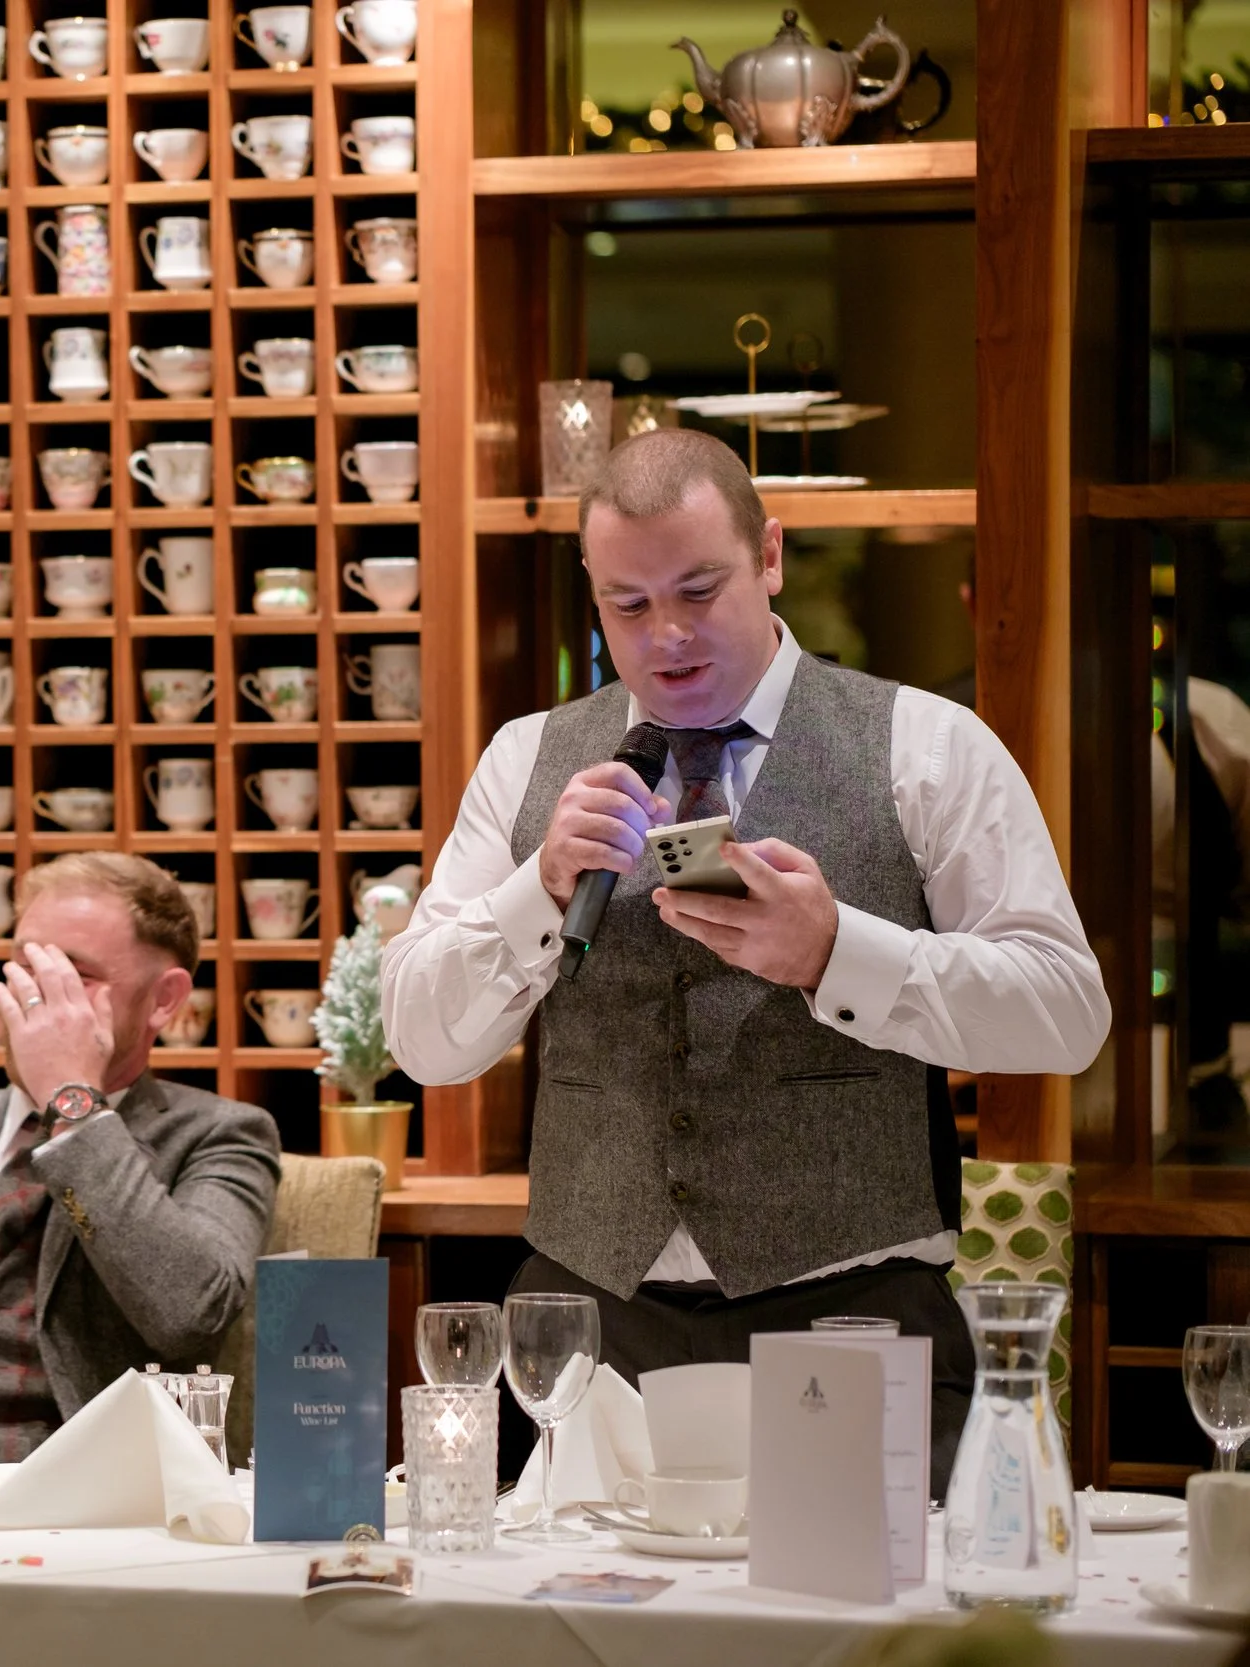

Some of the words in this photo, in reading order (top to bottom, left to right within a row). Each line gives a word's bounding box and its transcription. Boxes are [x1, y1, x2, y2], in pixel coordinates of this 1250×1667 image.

[294, 1356, 346, 1369] EUROPA
[294, 1402, 346, 1415] Function
[300, 1416, 321, 1426] Wine
